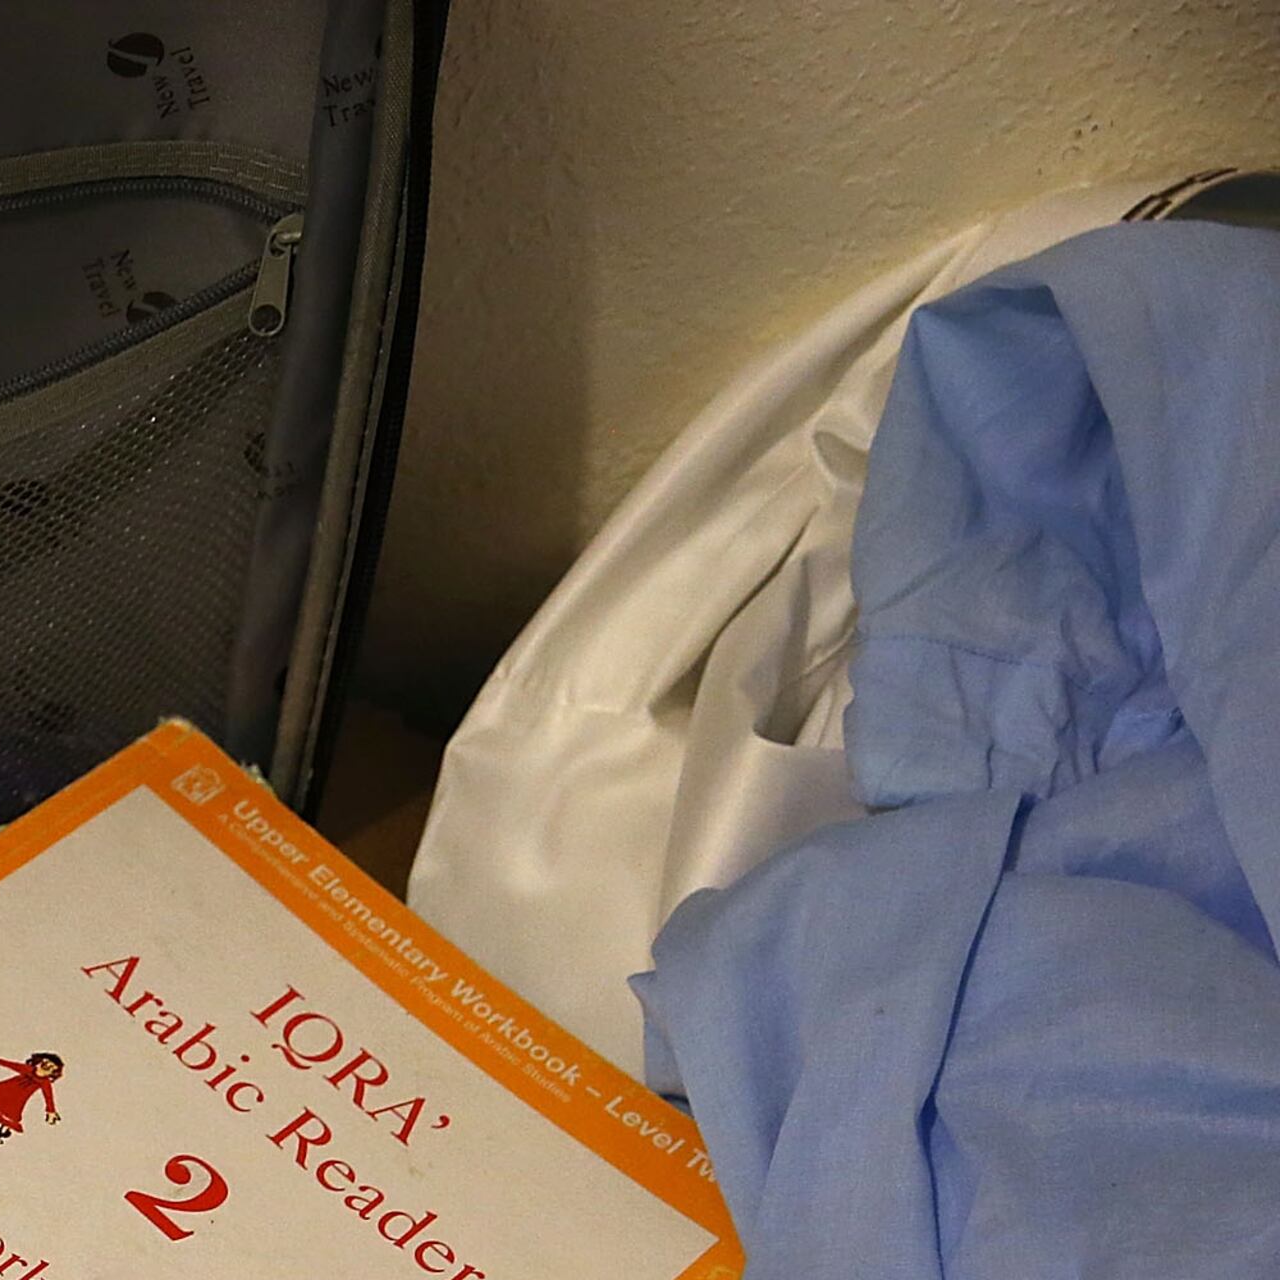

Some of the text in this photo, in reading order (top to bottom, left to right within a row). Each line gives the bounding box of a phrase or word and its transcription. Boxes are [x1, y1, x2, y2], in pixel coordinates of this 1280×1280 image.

[153, 75, 180, 119] New
[171, 47, 210, 111] Travel
[80, 955, 265, 1114] Arabic
[232, 799, 310, 866] Upper
[307, 863, 449, 985] Elementary
[449, 978, 584, 1088] Workbook
[603, 1095, 686, 1156] Level
[685, 1147, 719, 1184] Tw
[124, 1154, 229, 1242] 2
